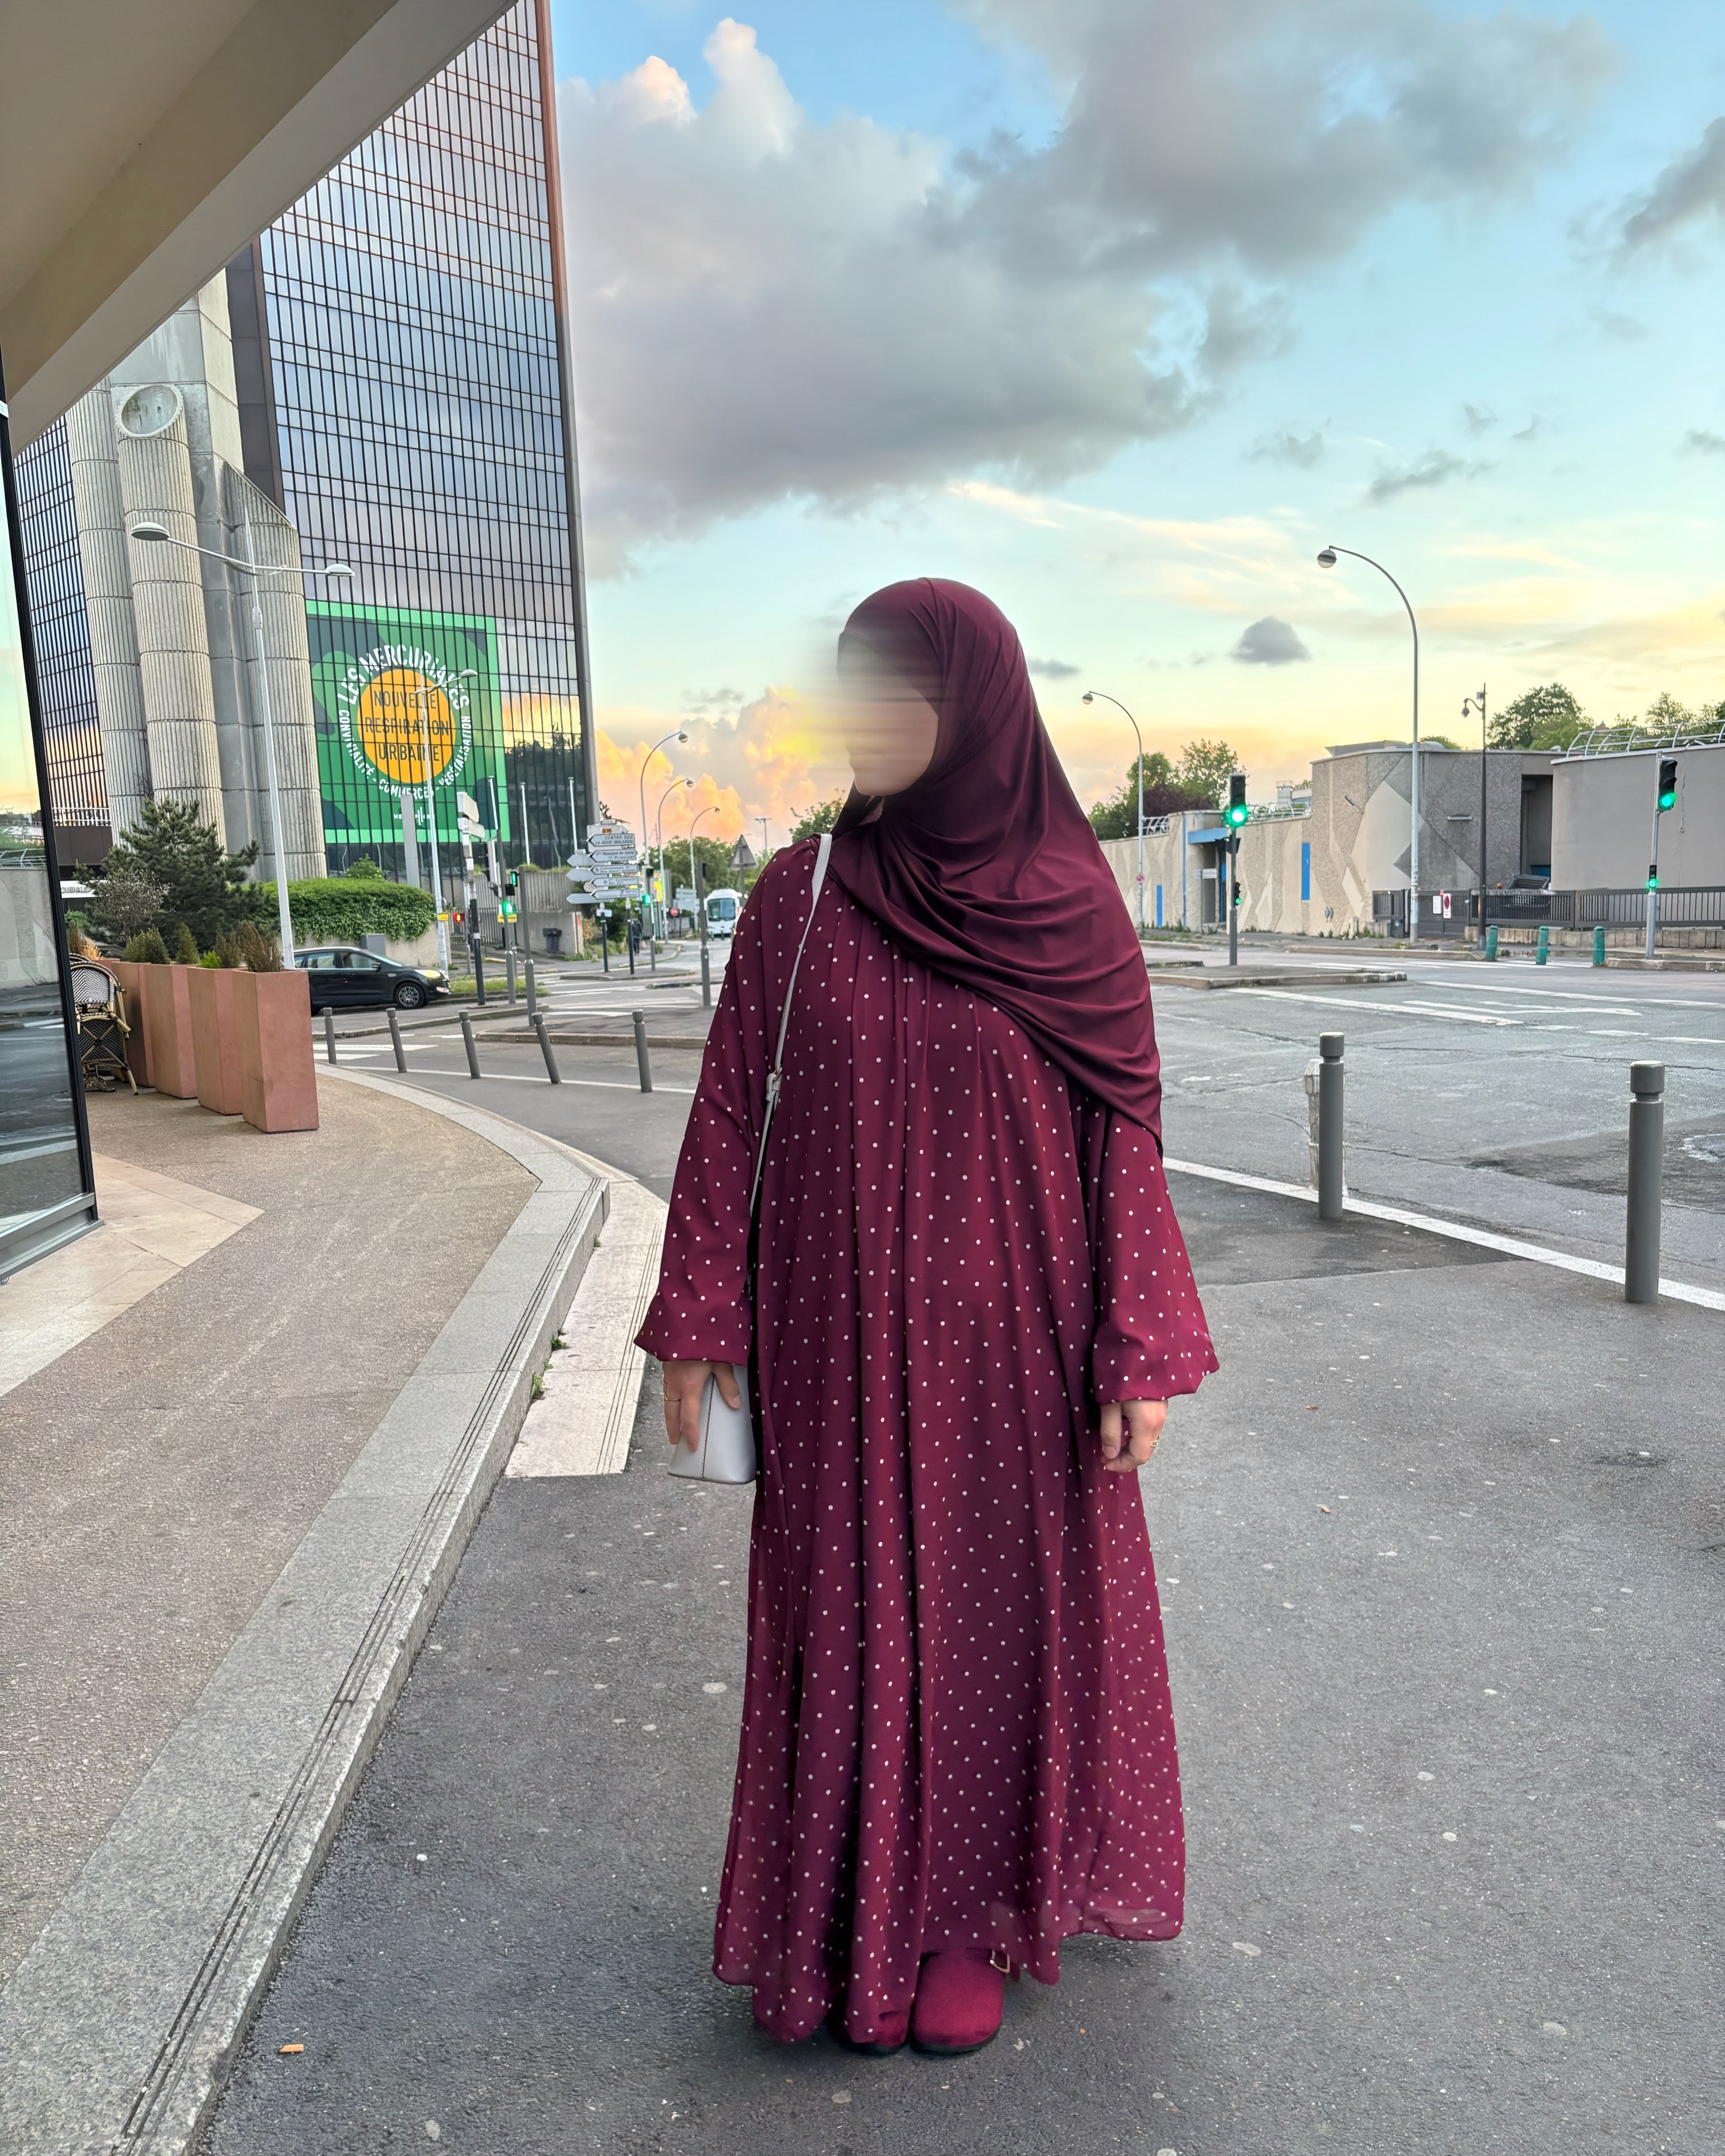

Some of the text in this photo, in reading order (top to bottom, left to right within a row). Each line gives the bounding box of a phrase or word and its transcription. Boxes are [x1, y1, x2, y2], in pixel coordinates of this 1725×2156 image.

[337, 644, 469, 710] LES MERCURIALES
[374, 690, 437, 709] NOUVELLE
[339, 710, 375, 779] CONVIVIALITÉ
[438, 715, 472, 788] VÉGÉTALISATION
[378, 744, 439, 761] URBAINE
